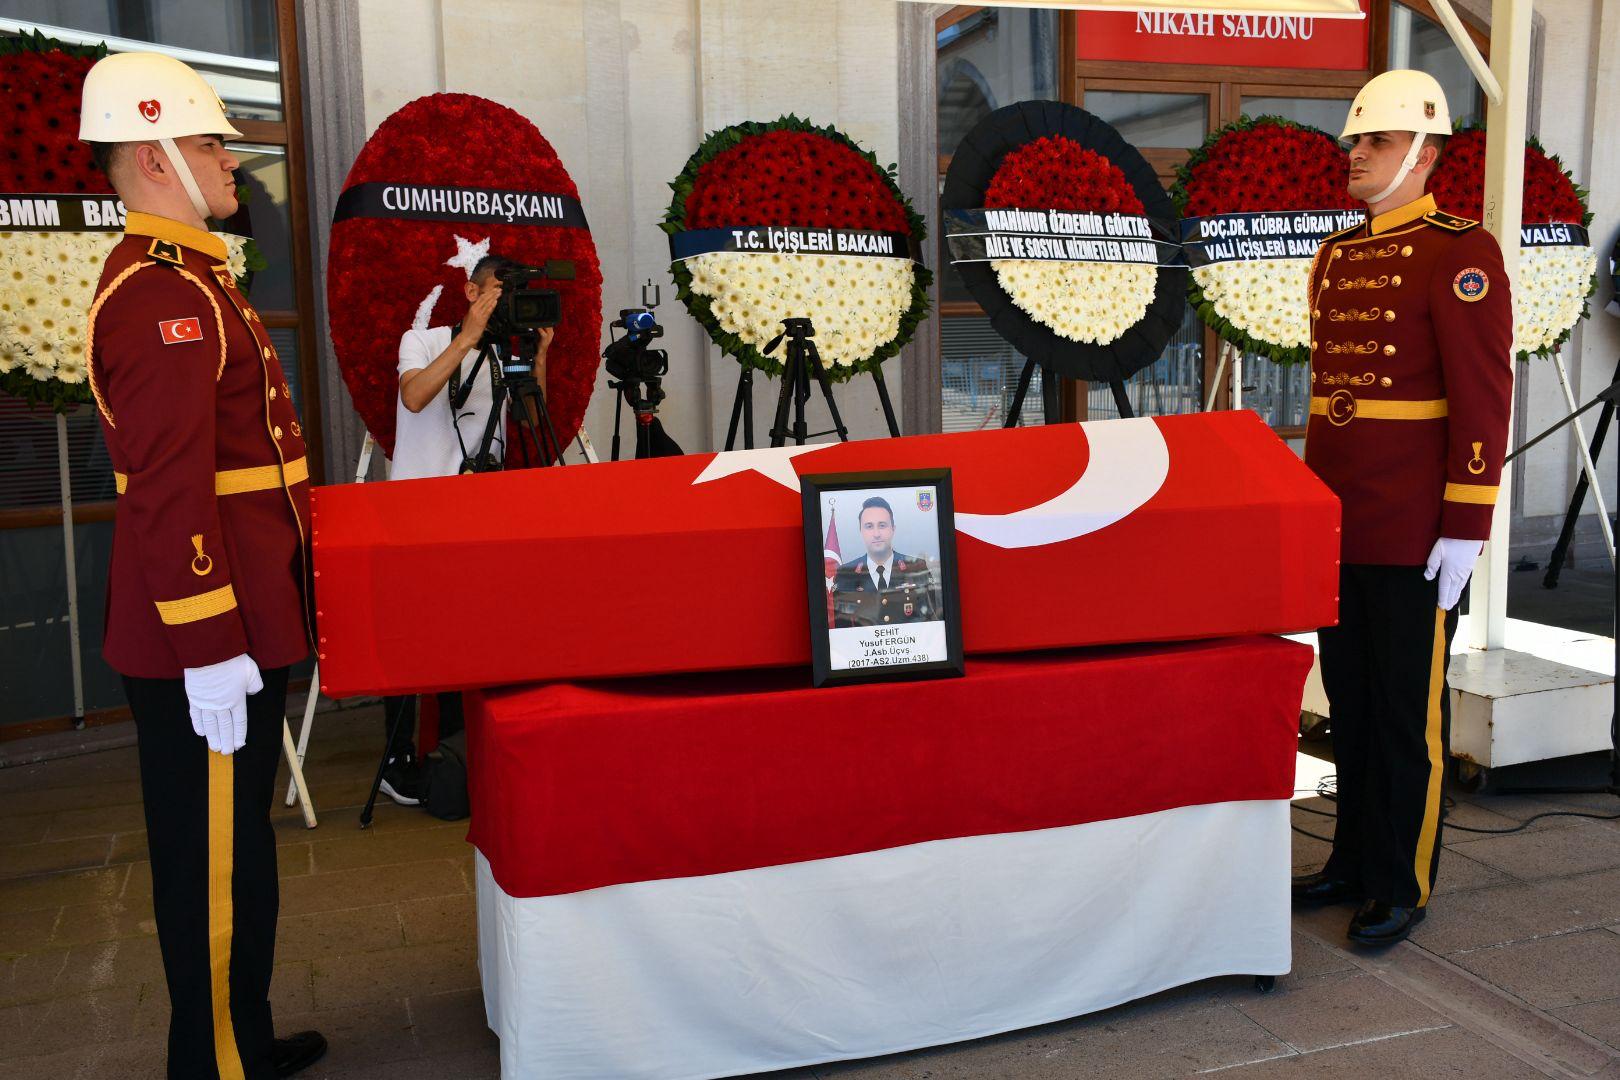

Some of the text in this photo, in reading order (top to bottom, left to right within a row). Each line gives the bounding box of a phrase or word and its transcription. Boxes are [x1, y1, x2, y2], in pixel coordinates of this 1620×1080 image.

[1222, 14, 1313, 40] SALONU
[382, 186, 563, 222] CUMHURBAŞKANI
[985, 208, 1049, 233] MAHİNUR
[1049, 209, 1104, 236] ÖZDEMİR
[1200, 218, 1249, 239] DOÇ.DR.
[1252, 215, 1291, 236] KÜBRA
[1294, 214, 1333, 234] GÜRAN
[1520, 224, 1572, 244] VALİSİ
[732, 227, 893, 254] T.C. İÇİŞLERİ BAKANI
[985, 233, 1158, 264] AİLE VE SOSYAL HİZMETLER BAKANI
[1205, 236, 1322, 261] VALİ İÇİŞLERİ BAKA
[859, 639, 883, 647] Yusuf
[874, 627, 900, 638] ŞEHİT
